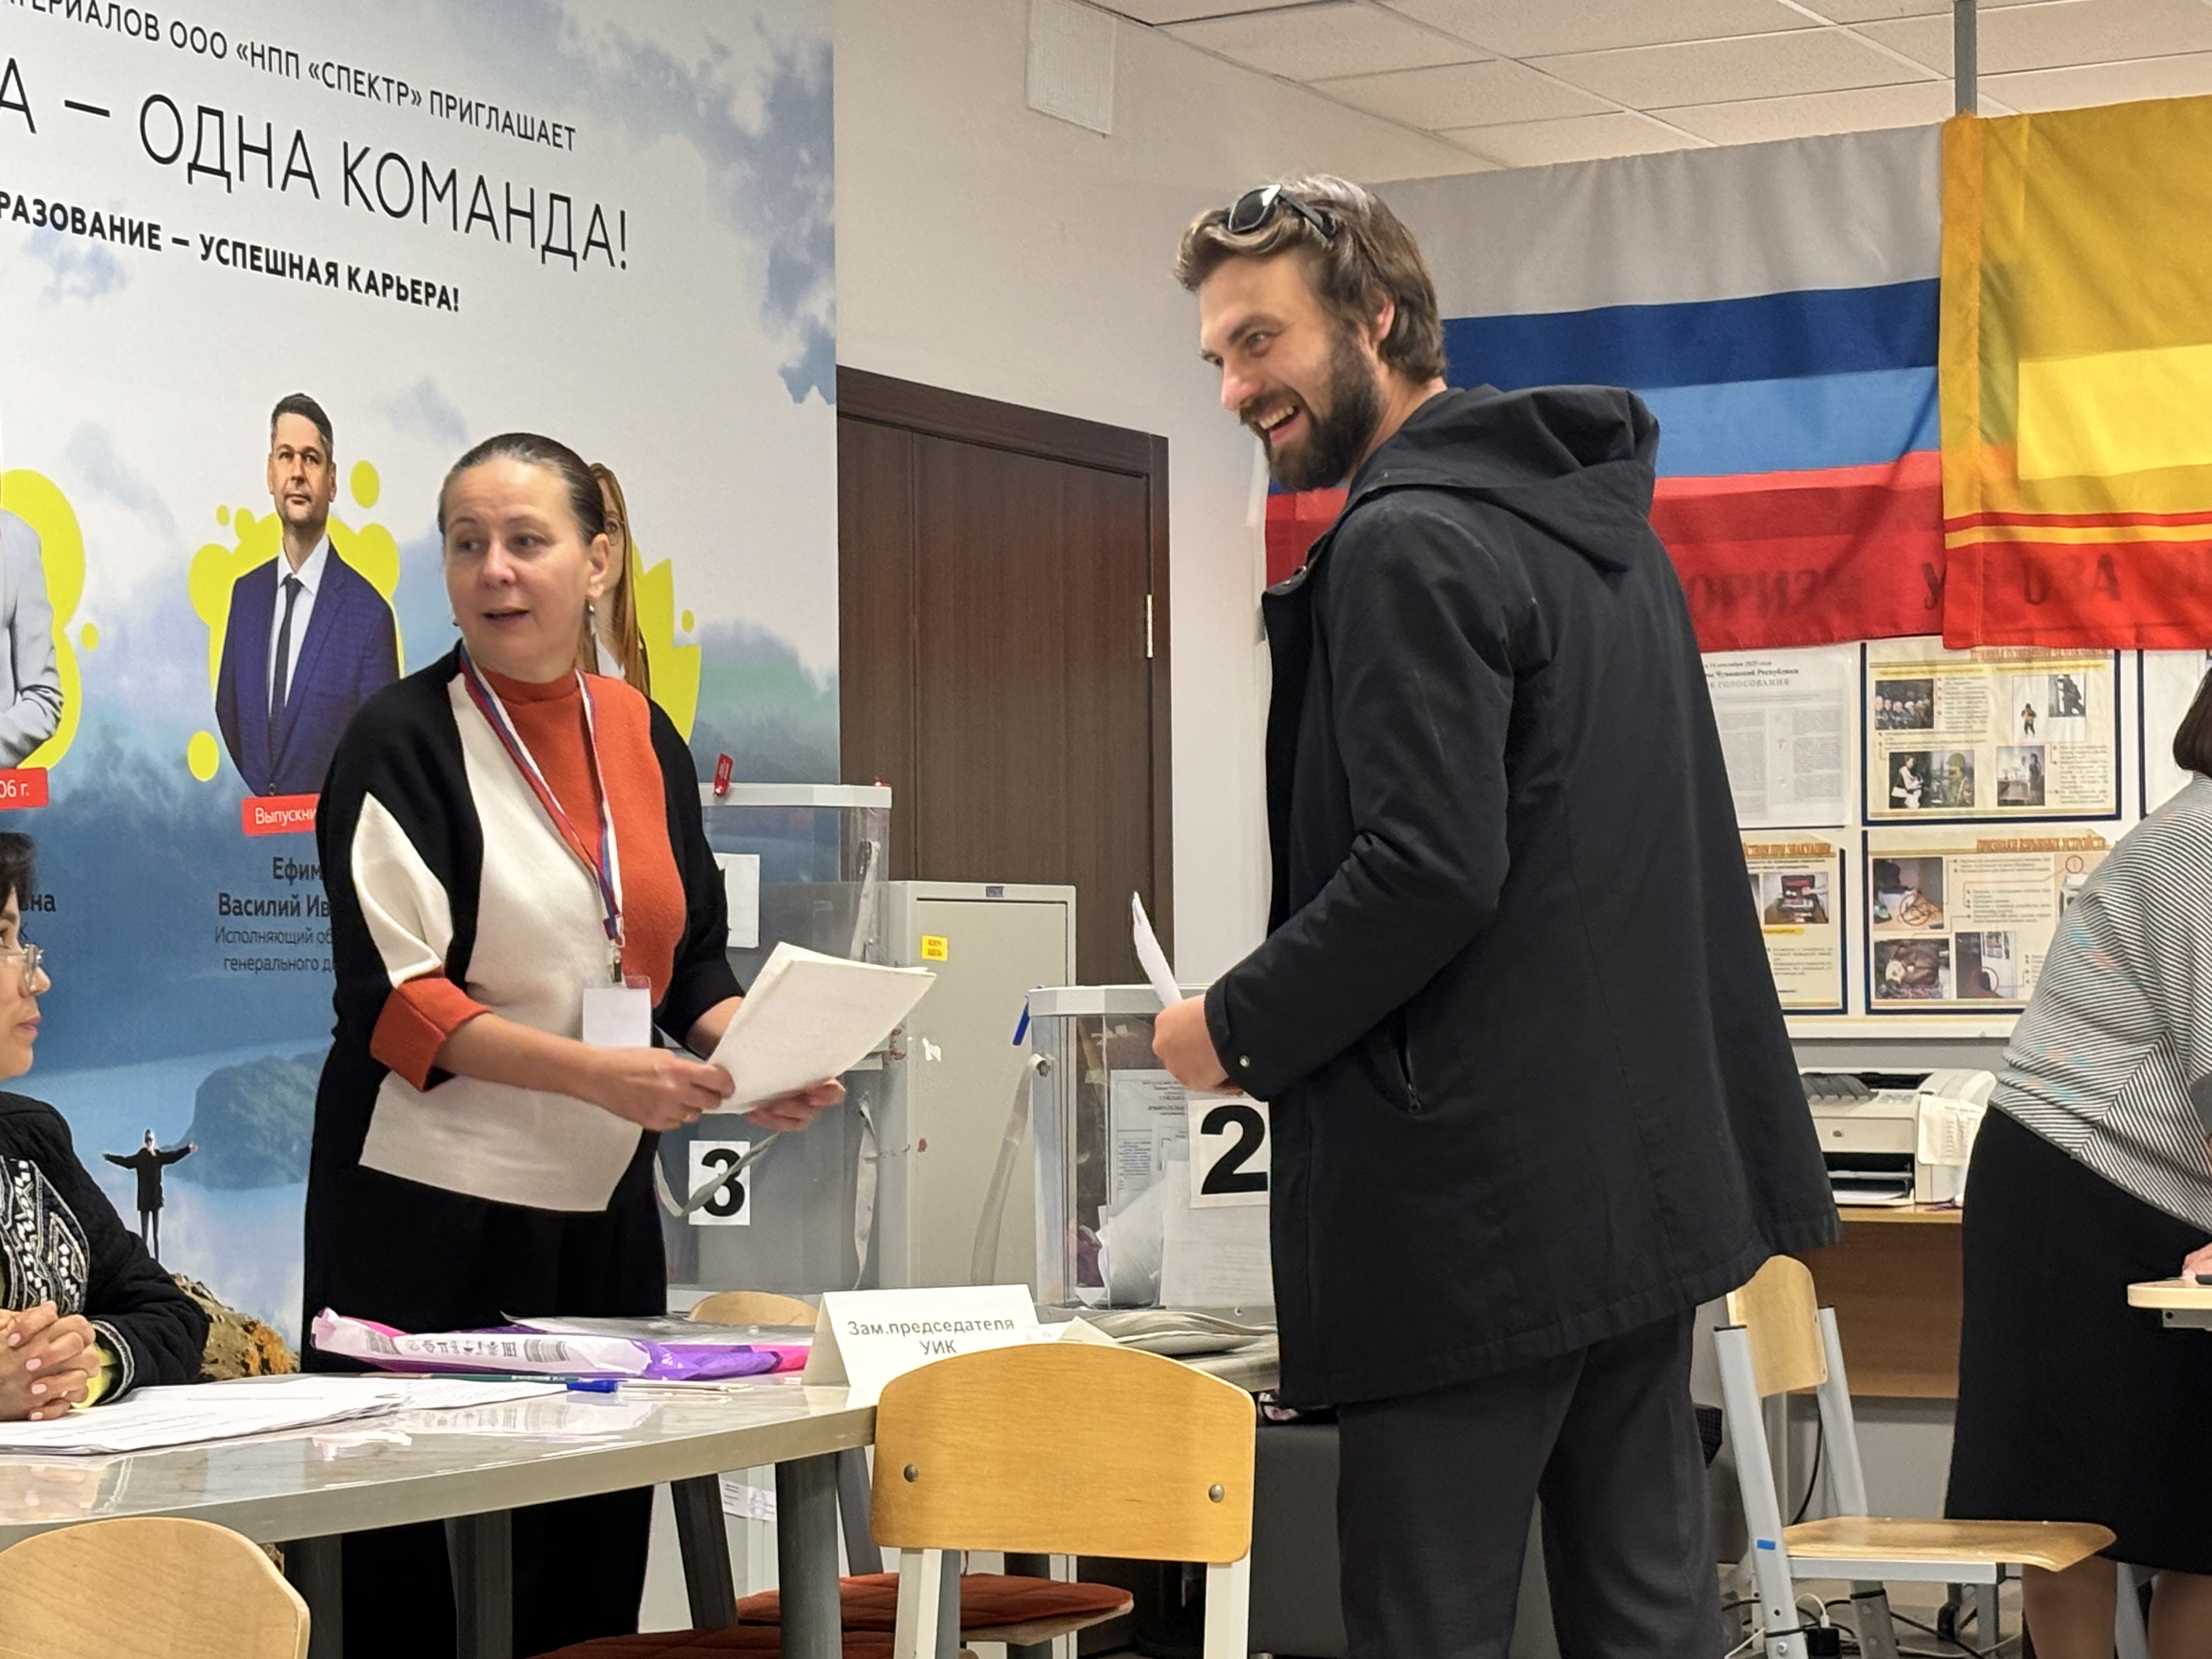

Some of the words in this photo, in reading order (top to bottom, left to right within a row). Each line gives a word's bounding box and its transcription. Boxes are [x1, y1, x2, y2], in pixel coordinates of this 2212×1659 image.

[170, 21, 228, 59] ООО
[236, 41, 300, 80] «НПП
[308, 61, 422, 106] «СПЕКТР»
[430, 89, 576, 151] ПРИГЛАШАЕТ
[139, 94, 320, 200] ОДНА
[343, 141, 627, 271] КОМАНДА!
[0, 190, 162, 252] РАЗОВАНИЕ
[199, 233, 339, 289] УСПЕШНАЯ
[347, 265, 459, 313] КАРЬЕРА!
[20, 783, 30, 797] г.
[273, 856, 323, 887] Ефим
[218, 892, 301, 917] Василий
[215, 926, 314, 945] Исполняющий
[223, 957, 319, 975] генерального
[1200, 1104, 1268, 1195] 2
[701, 1148, 745, 1217] 3
[847, 1319, 1015, 1338] Зам.председателя
[918, 1339, 957, 1355] УИК
